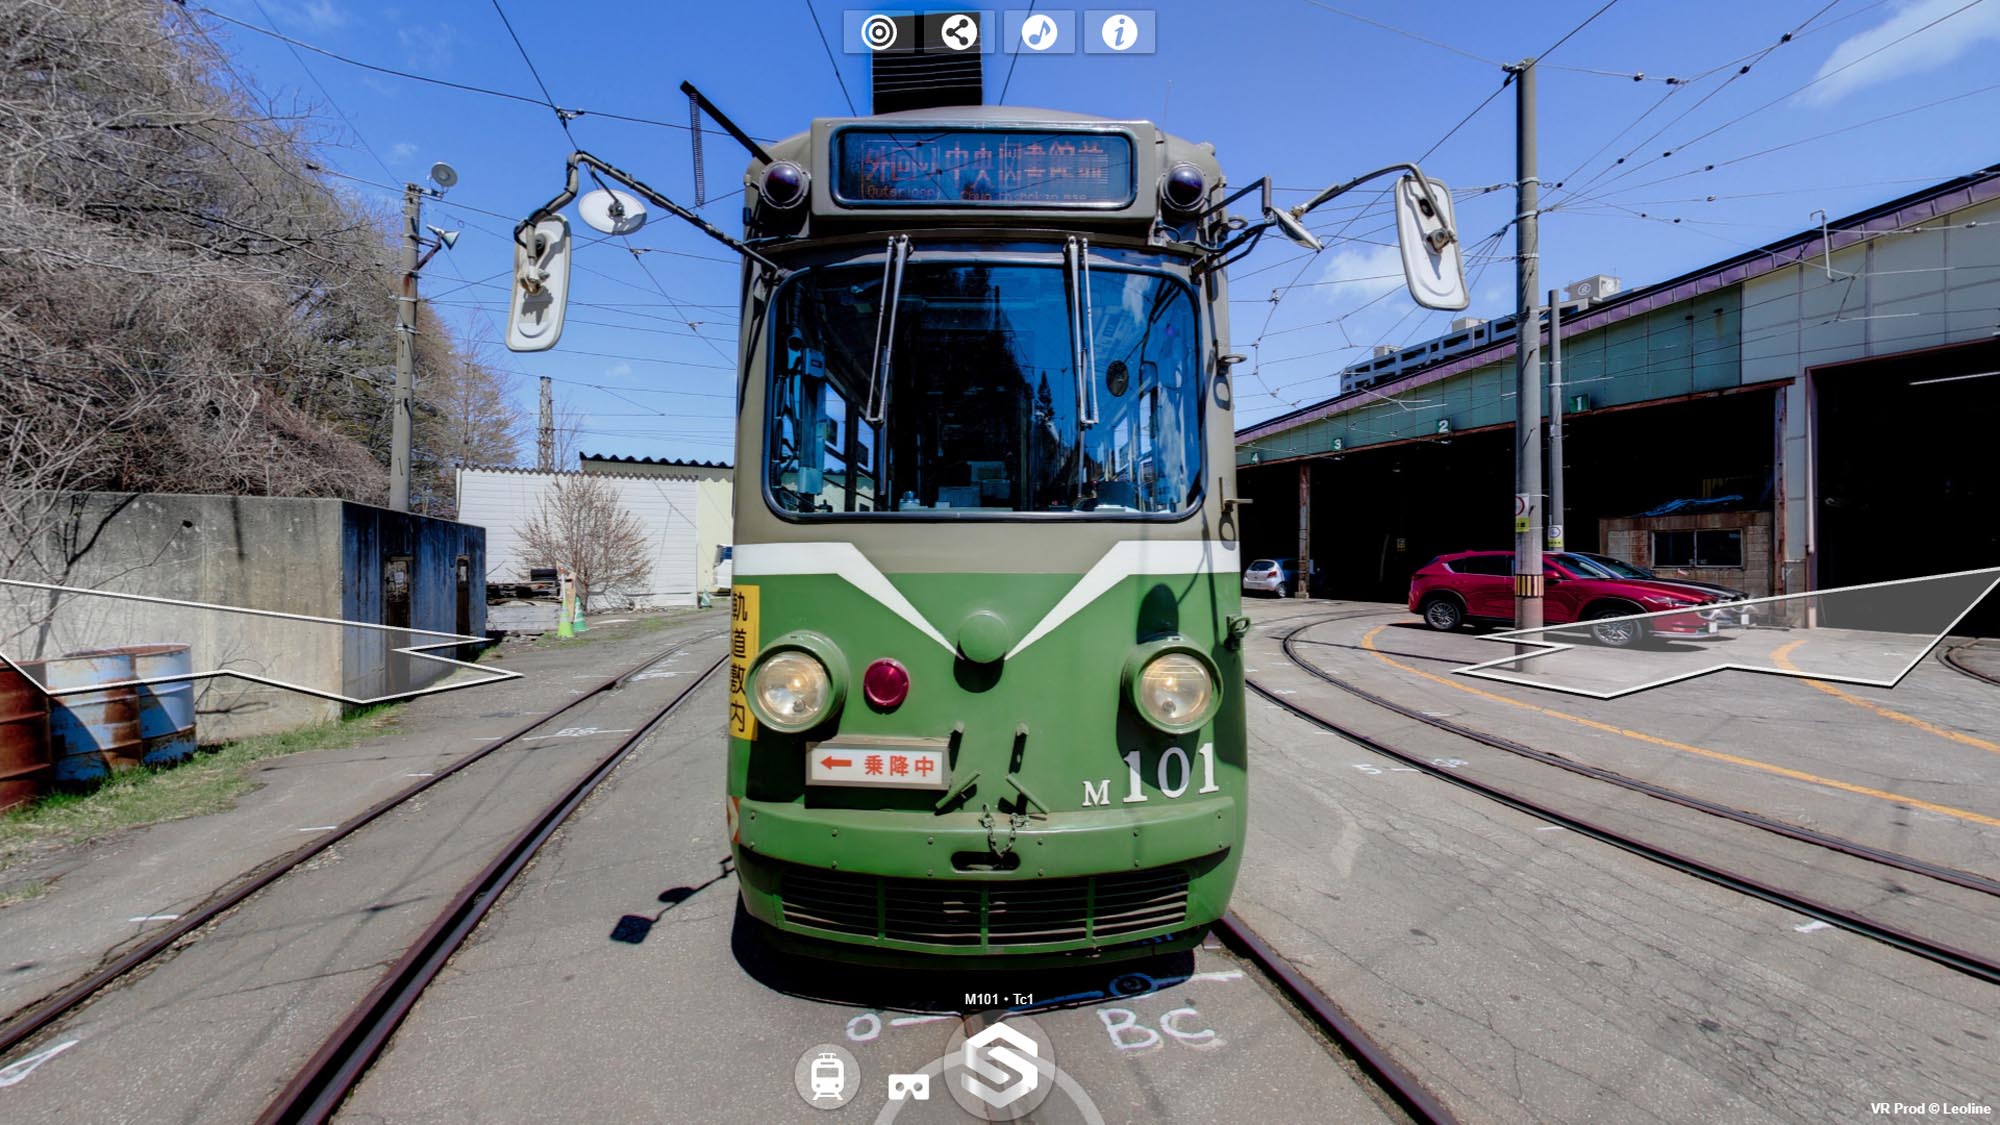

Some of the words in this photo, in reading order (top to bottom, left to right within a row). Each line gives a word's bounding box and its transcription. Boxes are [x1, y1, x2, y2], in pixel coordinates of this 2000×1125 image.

[1438, 419, 1449, 433] 2
[1334, 438, 1342, 450] 3
[1252, 453, 1259, 463] 4
[864, 754, 935, 778] 乗降中
